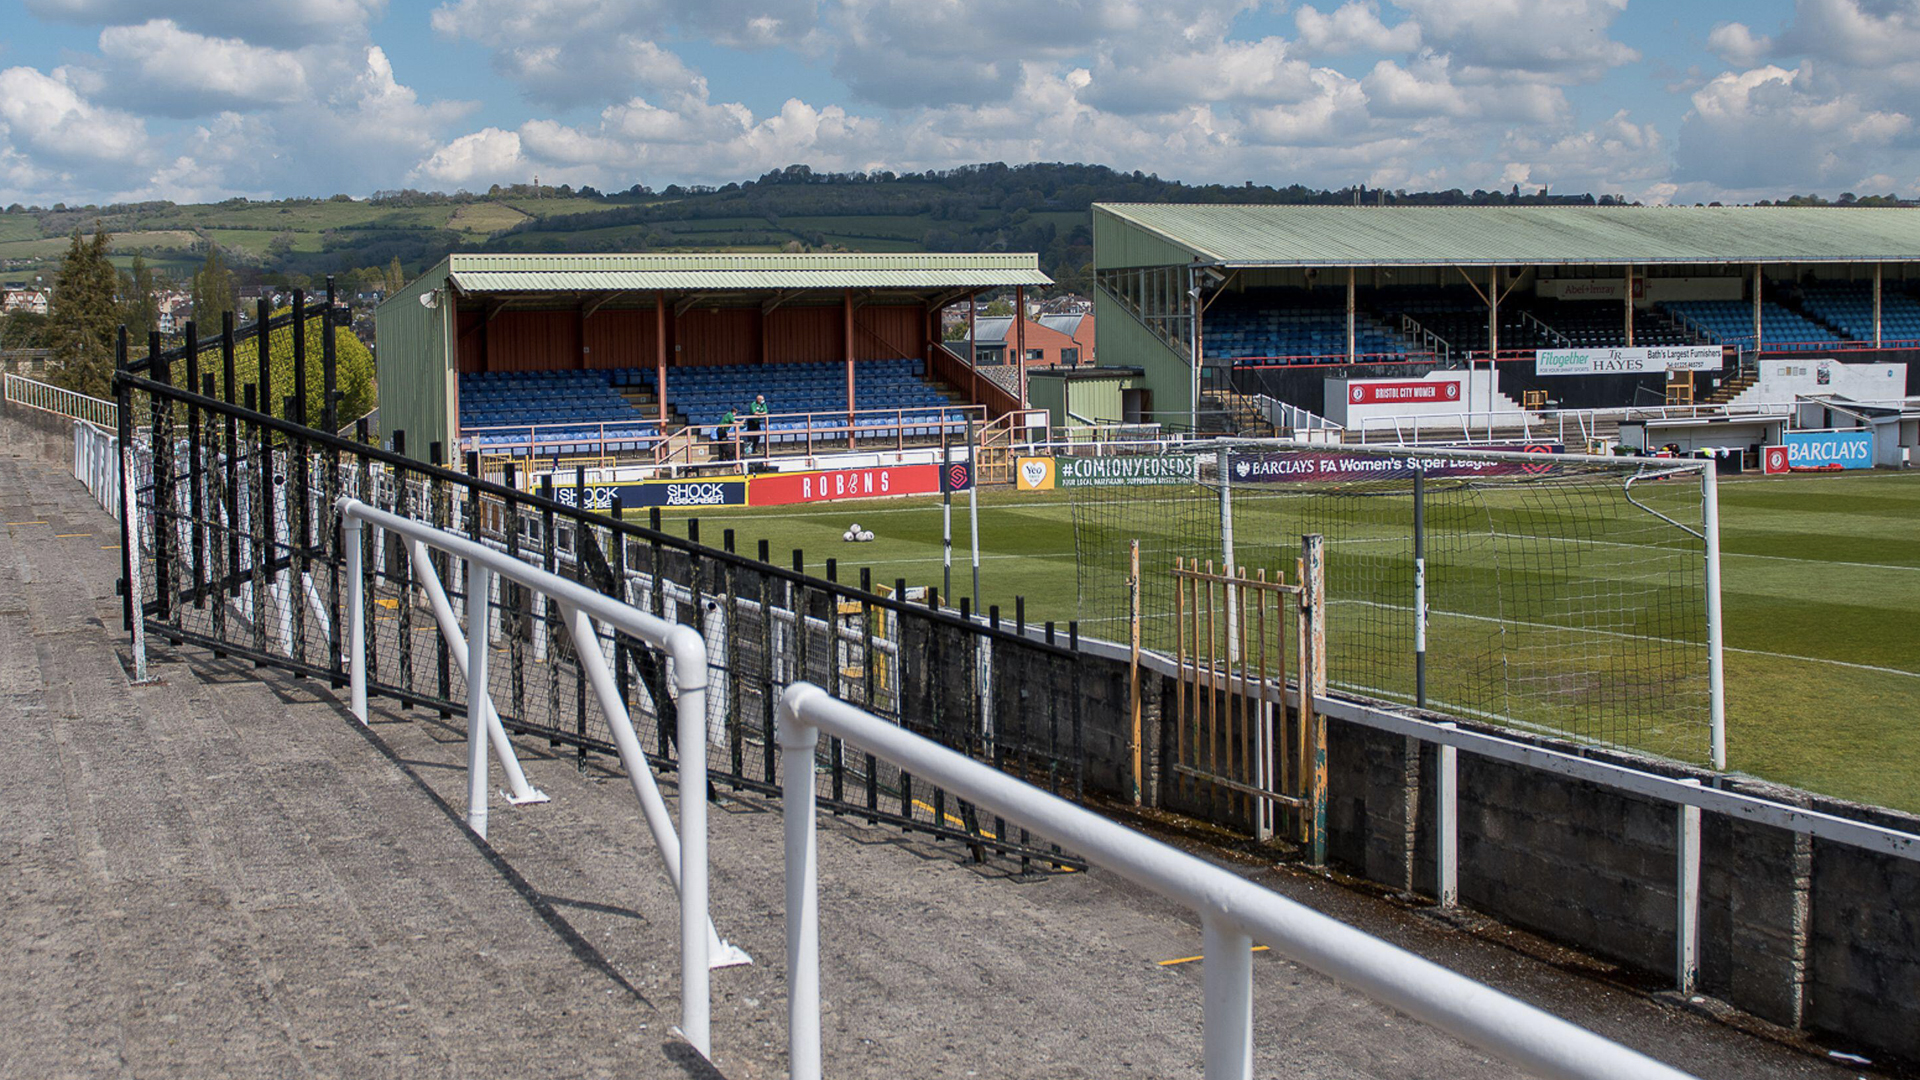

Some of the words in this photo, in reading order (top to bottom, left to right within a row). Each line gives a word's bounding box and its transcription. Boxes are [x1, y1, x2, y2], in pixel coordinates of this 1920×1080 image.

[1541, 351, 1589, 367] Fitogether
[1648, 349, 1666, 359] Bath's
[1667, 349, 1689, 360] Largest
[1690, 348, 1721, 358] Furnishers
[1593, 360, 1644, 371] HAYES
[1375, 387, 1399, 399] BRISTOL
[1400, 387, 1412, 398] CITY
[1413, 386, 1436, 398] WOMEN
[1788, 441, 1868, 461] BARCLAYS
[1026, 465, 1042, 475] Yeo
[1252, 459, 1314, 475] BARCLAYS
[1319, 459, 1338, 473] FA
[1339, 457, 1402, 472] Women's
[667, 483, 724, 498] SHOCK
[666, 496, 725, 505] ABSORBER
